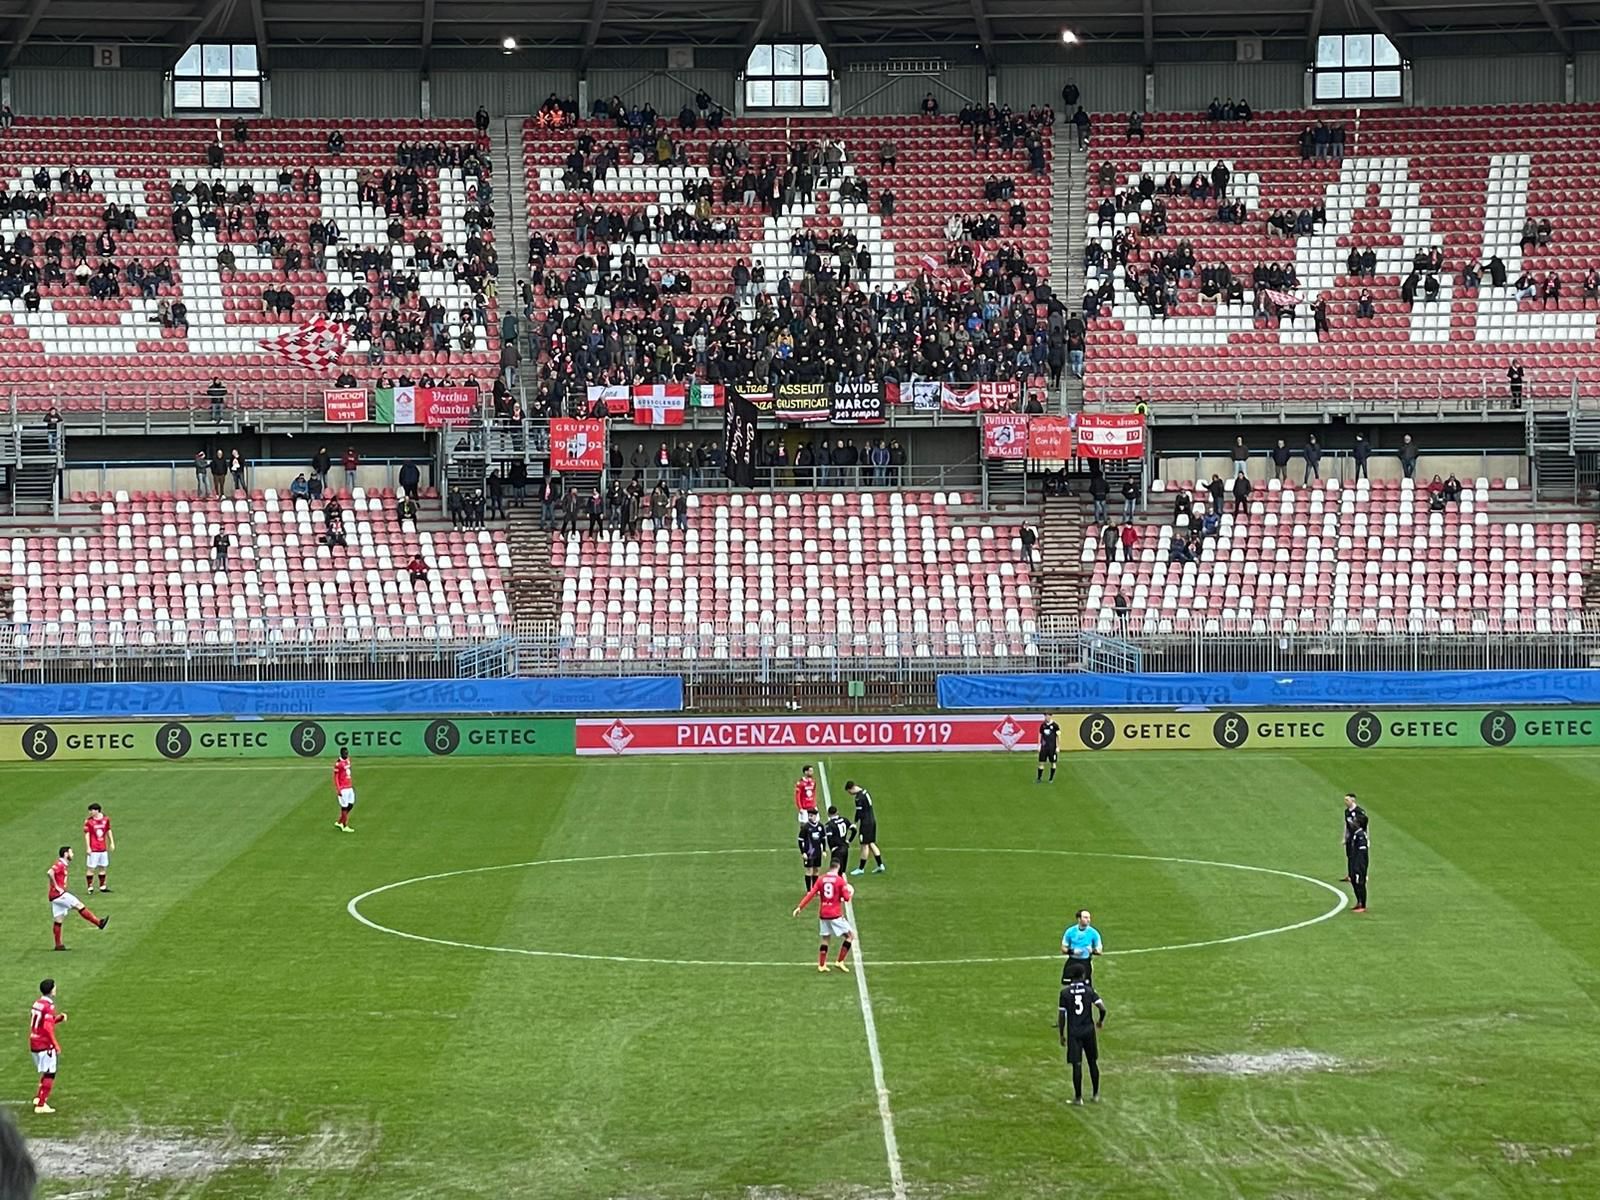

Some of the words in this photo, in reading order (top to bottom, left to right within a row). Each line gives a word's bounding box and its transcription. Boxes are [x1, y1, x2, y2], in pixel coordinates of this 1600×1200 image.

[101, 49, 113, 66] B
[834, 382, 879, 394] DAVIDE
[431, 390, 469, 403] Vecchia
[776, 398, 829, 409] GIUSTIFICATI
[834, 398, 881, 409] MARCO
[429, 403, 471, 415] Guardia
[835, 410, 850, 420] per
[851, 410, 880, 420] sempre
[555, 424, 600, 432] GRUPPO
[1096, 416, 1113, 426] hoc
[1082, 431, 1093, 441] 19
[1128, 431, 1139, 441] 19
[554, 440, 566, 450] 19
[588, 440, 602, 450] 92
[988, 446, 1024, 456] BRIGADE
[555, 459, 601, 468] PLACENTIA
[1048, 681, 1101, 699] ARM
[254, 699, 314, 713] Franchi
[677, 724, 797, 744] PIACENZA
[804, 722, 894, 744] CALCIO
[902, 721, 952, 743] 1919
[1123, 723, 1191, 739] GETEC
[1257, 722, 1325, 738] GETEC
[1390, 721, 1458, 737] GETEC
[1524, 720, 1592, 736] GETEC
[66, 734, 134, 749] GETEC
[200, 732, 268, 748] GETEC
[334, 731, 402, 747] GETEC
[468, 729, 536, 746] GETEC
[837, 821, 847, 838] 10
[823, 882, 834, 899] 9
